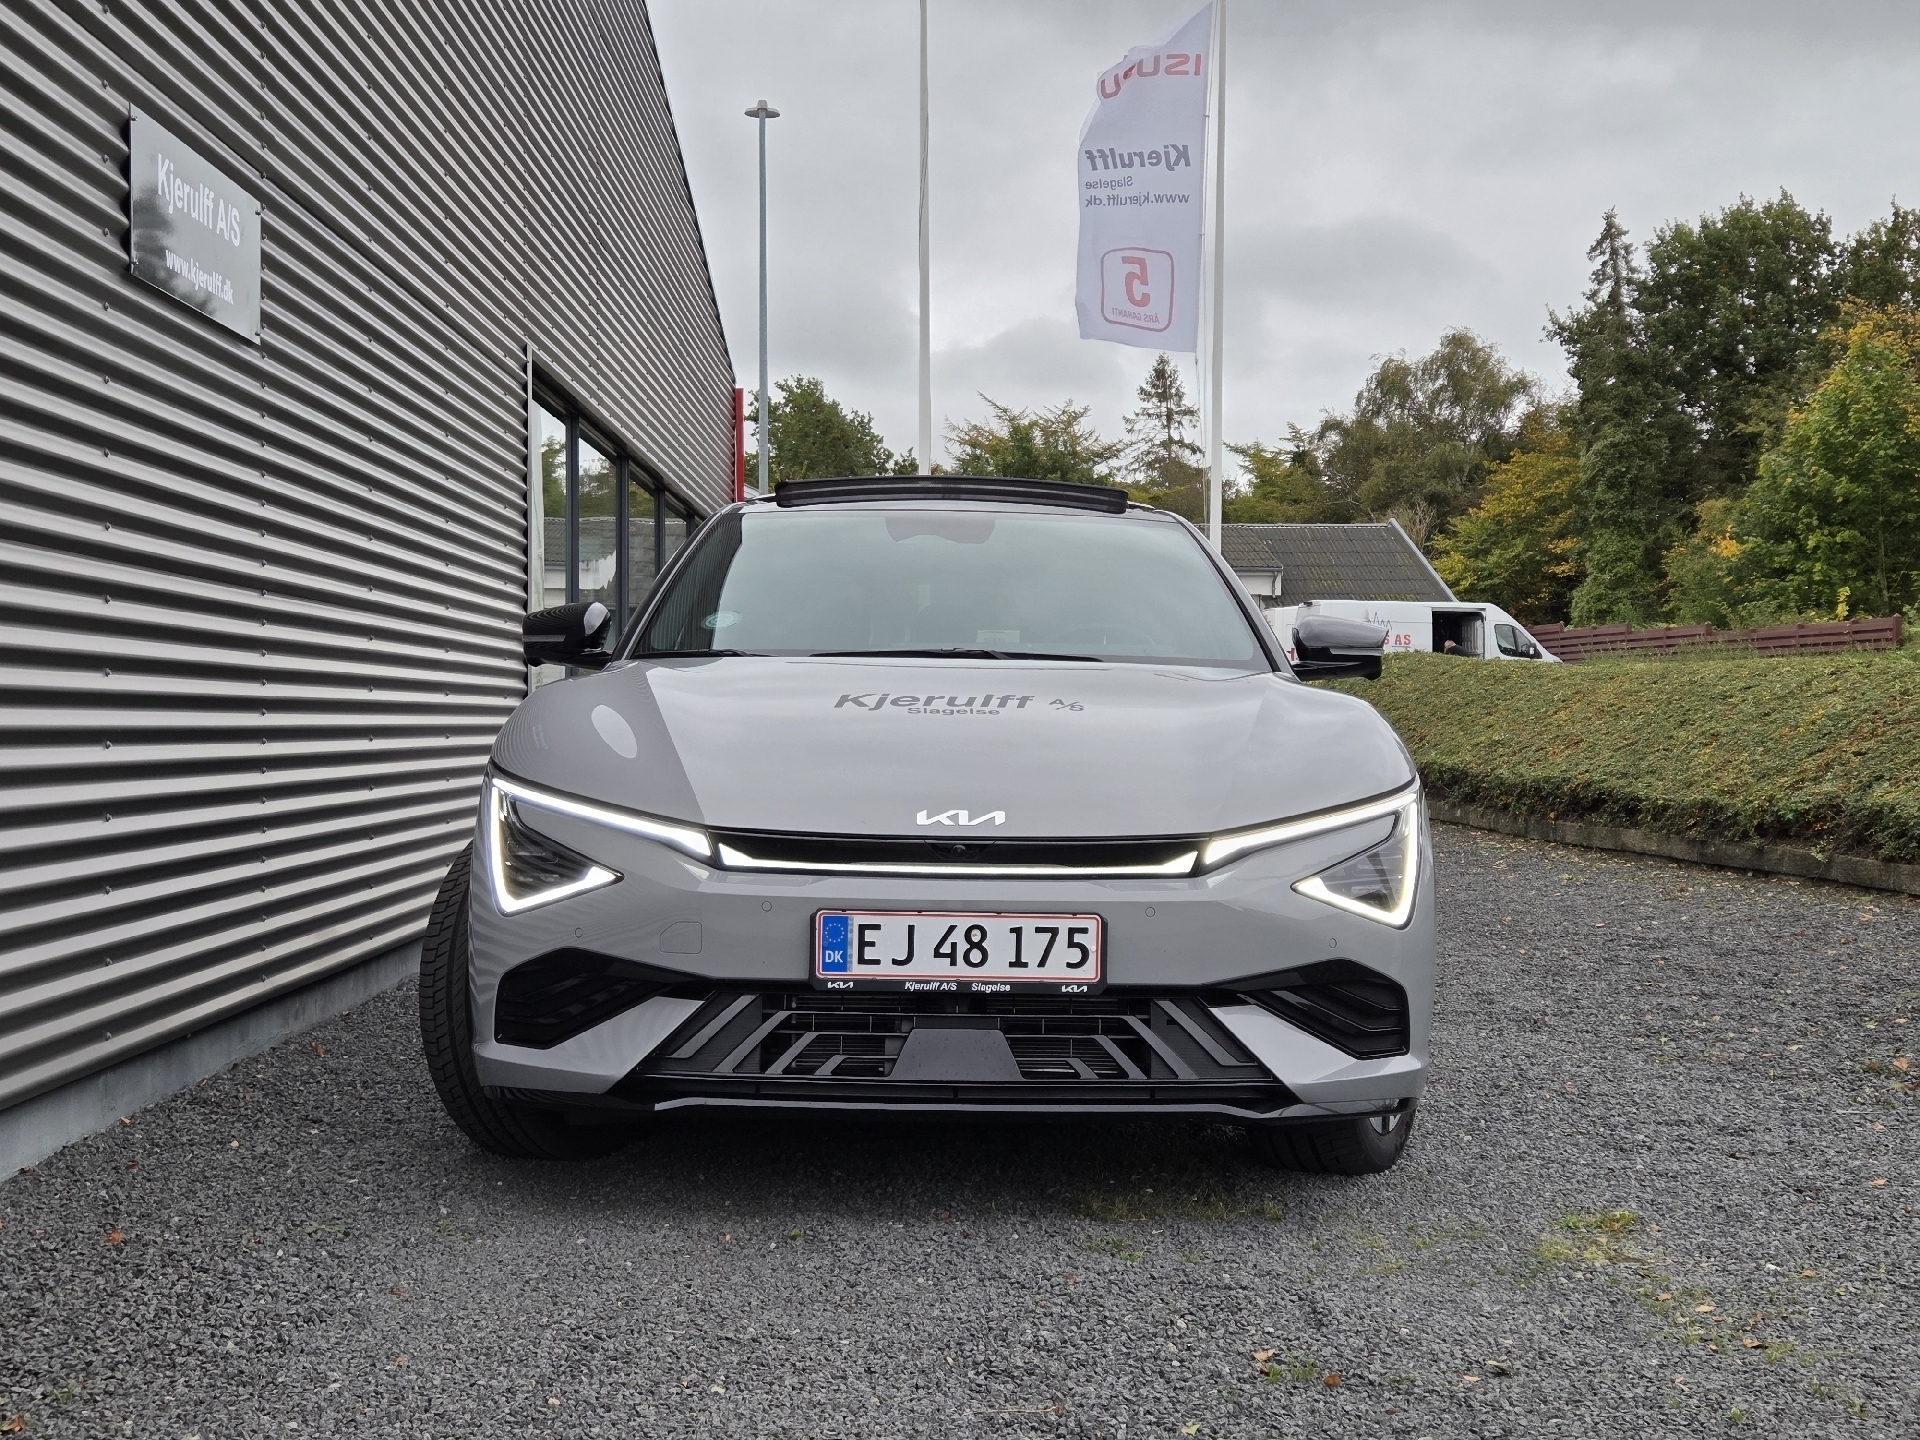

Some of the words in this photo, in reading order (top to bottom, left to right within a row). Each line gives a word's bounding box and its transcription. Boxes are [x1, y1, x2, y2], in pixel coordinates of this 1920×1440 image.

[157, 153, 214, 230] Kjerulff
[216, 198, 241, 247] A/S
[165, 249, 234, 305] www.kjerulff.dk
[1394, 634, 1411, 645] AS
[834, 693, 1035, 711] Kjerulff
[1048, 698, 1085, 712] A/S
[907, 707, 1000, 716] Slagelse
[916, 809, 1006, 826] KIA
[857, 923, 916, 967] EJ
[933, 924, 990, 968] 48
[1008, 926, 1090, 969] 175
[825, 950, 844, 964] DK
[904, 981, 939, 991] Kjerulff
[940, 981, 957, 991] A/S
[971, 982, 1011, 992] Slagelse
